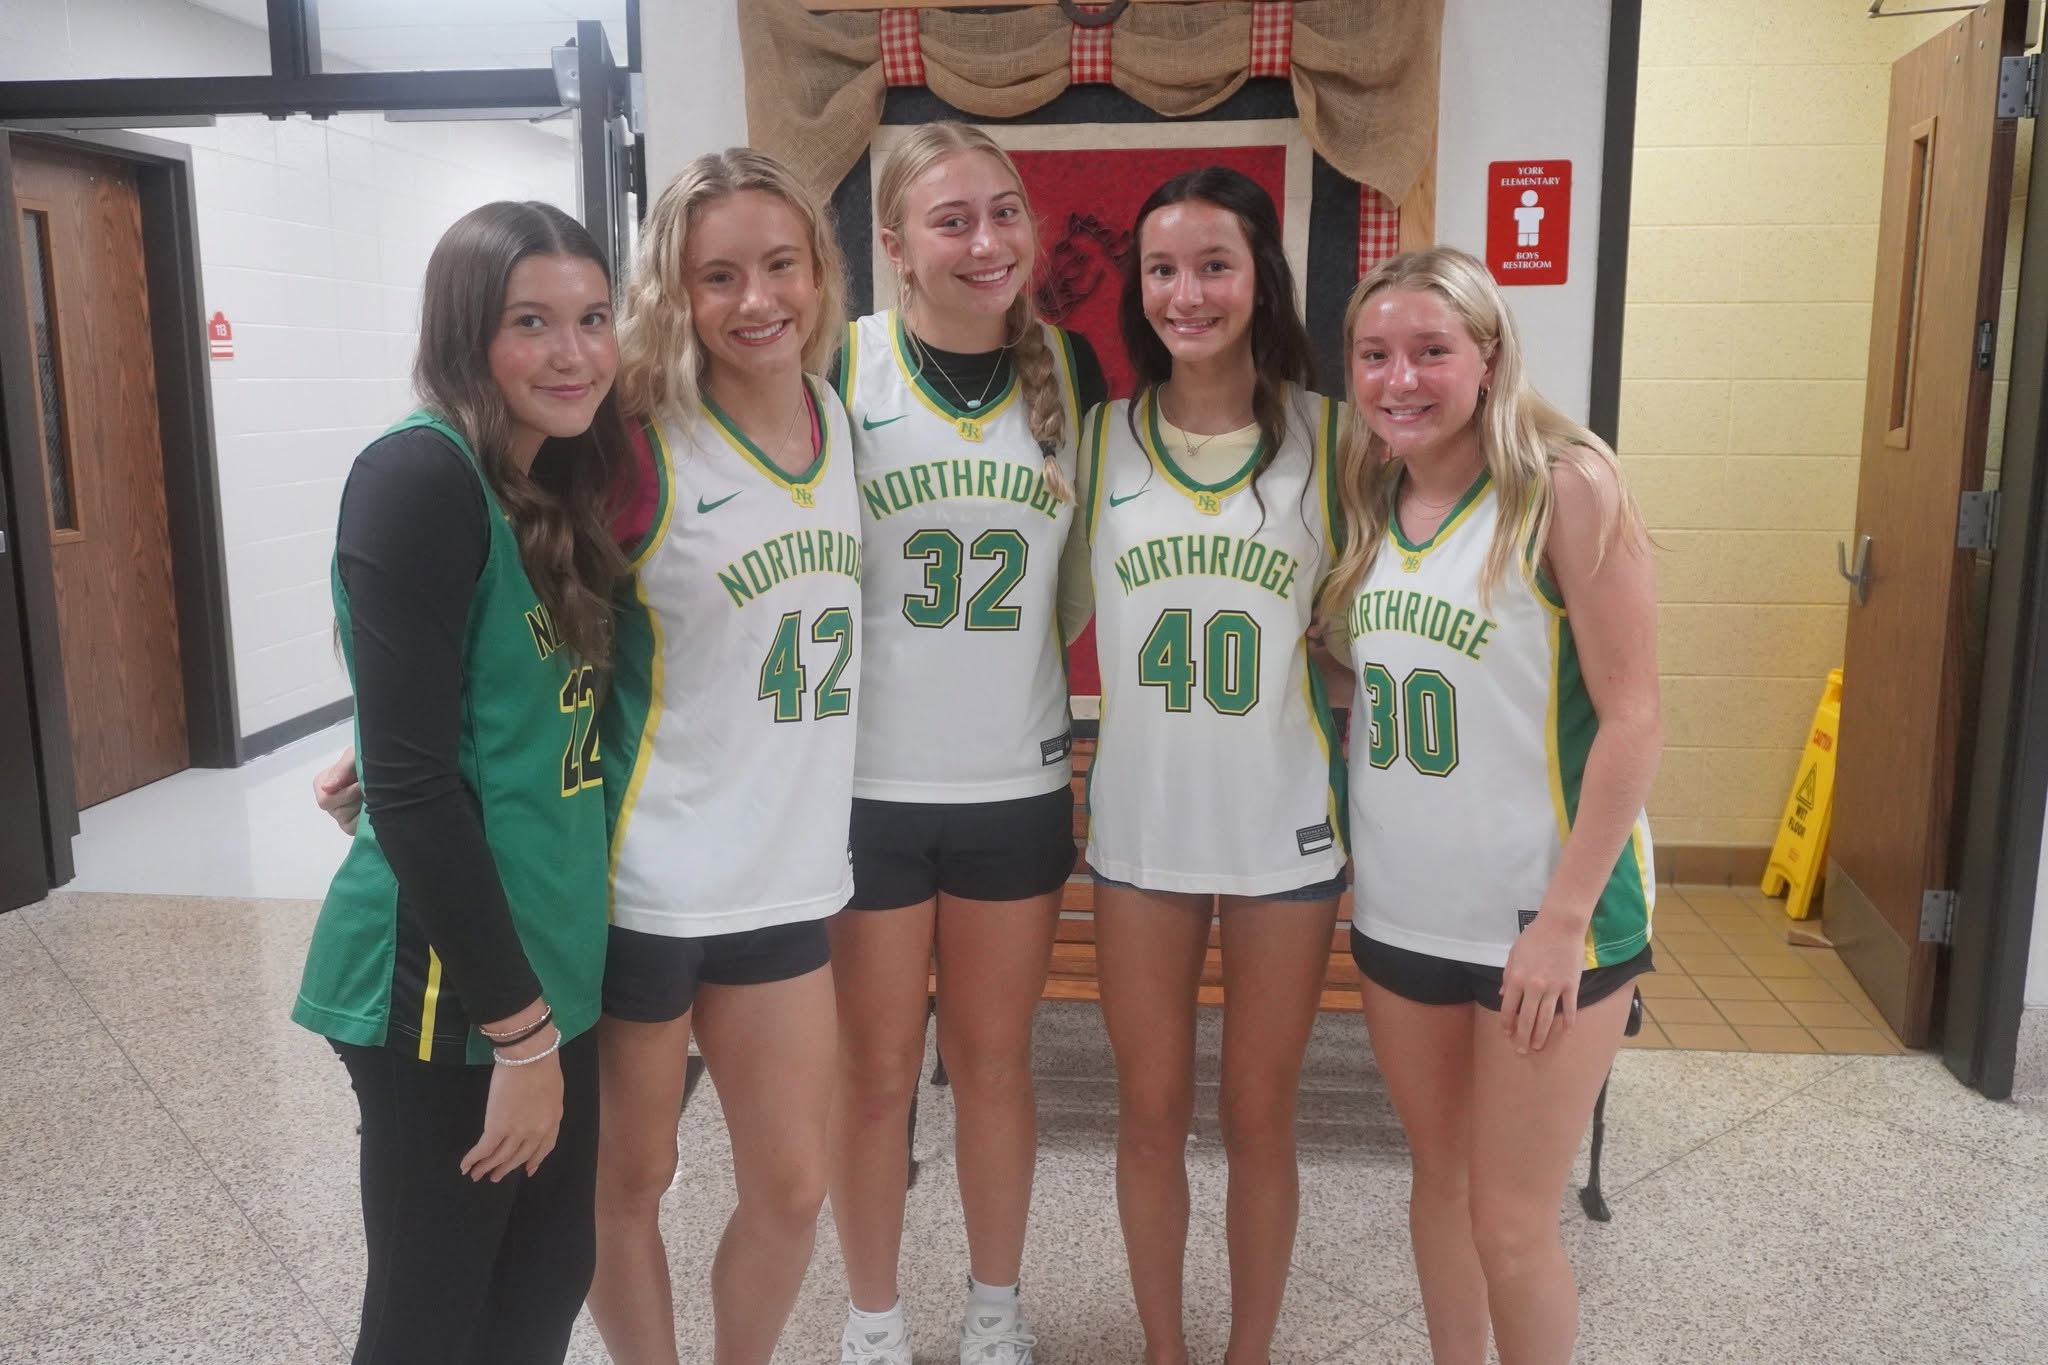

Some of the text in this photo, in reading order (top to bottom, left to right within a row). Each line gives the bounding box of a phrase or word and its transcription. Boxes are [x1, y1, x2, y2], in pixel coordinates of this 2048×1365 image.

[1501, 177, 1560, 186] ELEMENTARY
[1518, 166, 1544, 175] YORK
[1503, 260, 1552, 269] RESTROOM
[1516, 251, 1539, 260] BOYS
[1198, 495, 1217, 512] NR
[1114, 534, 1298, 600] NORTHRIDGE
[902, 529, 1029, 631] 32
[1347, 590, 1497, 660] ORTHRIDGE
[758, 607, 853, 723] 42
[1138, 608, 1261, 716] 40
[1364, 662, 1459, 778] 30
[1796, 804, 1808, 821] WET
[1788, 816, 1806, 839] FLOOR
